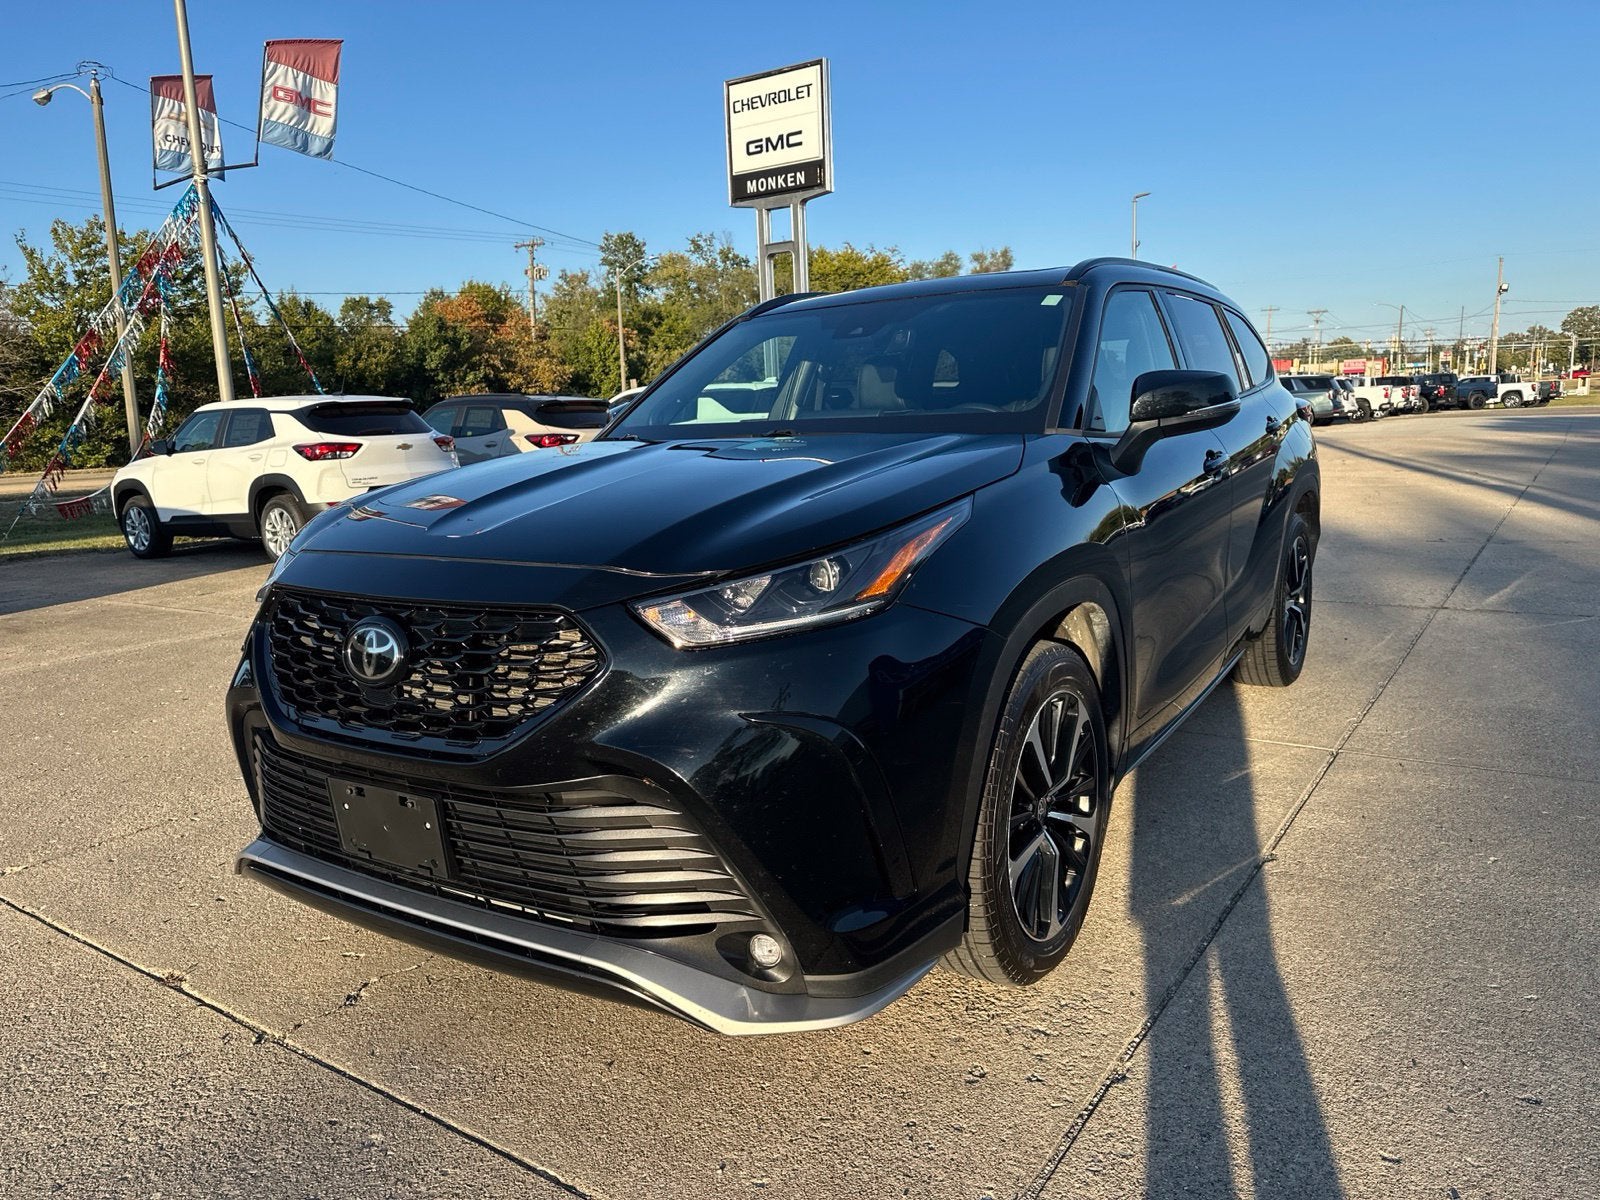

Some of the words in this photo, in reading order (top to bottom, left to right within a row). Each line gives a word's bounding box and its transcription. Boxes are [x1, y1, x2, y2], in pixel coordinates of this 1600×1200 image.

[272, 86, 332, 117] GMC
[732, 83, 813, 114] CHEVROLET
[164, 134, 220, 153] CHEVOLET
[746, 130, 803, 156] GMC
[746, 171, 805, 193] MONKEN
